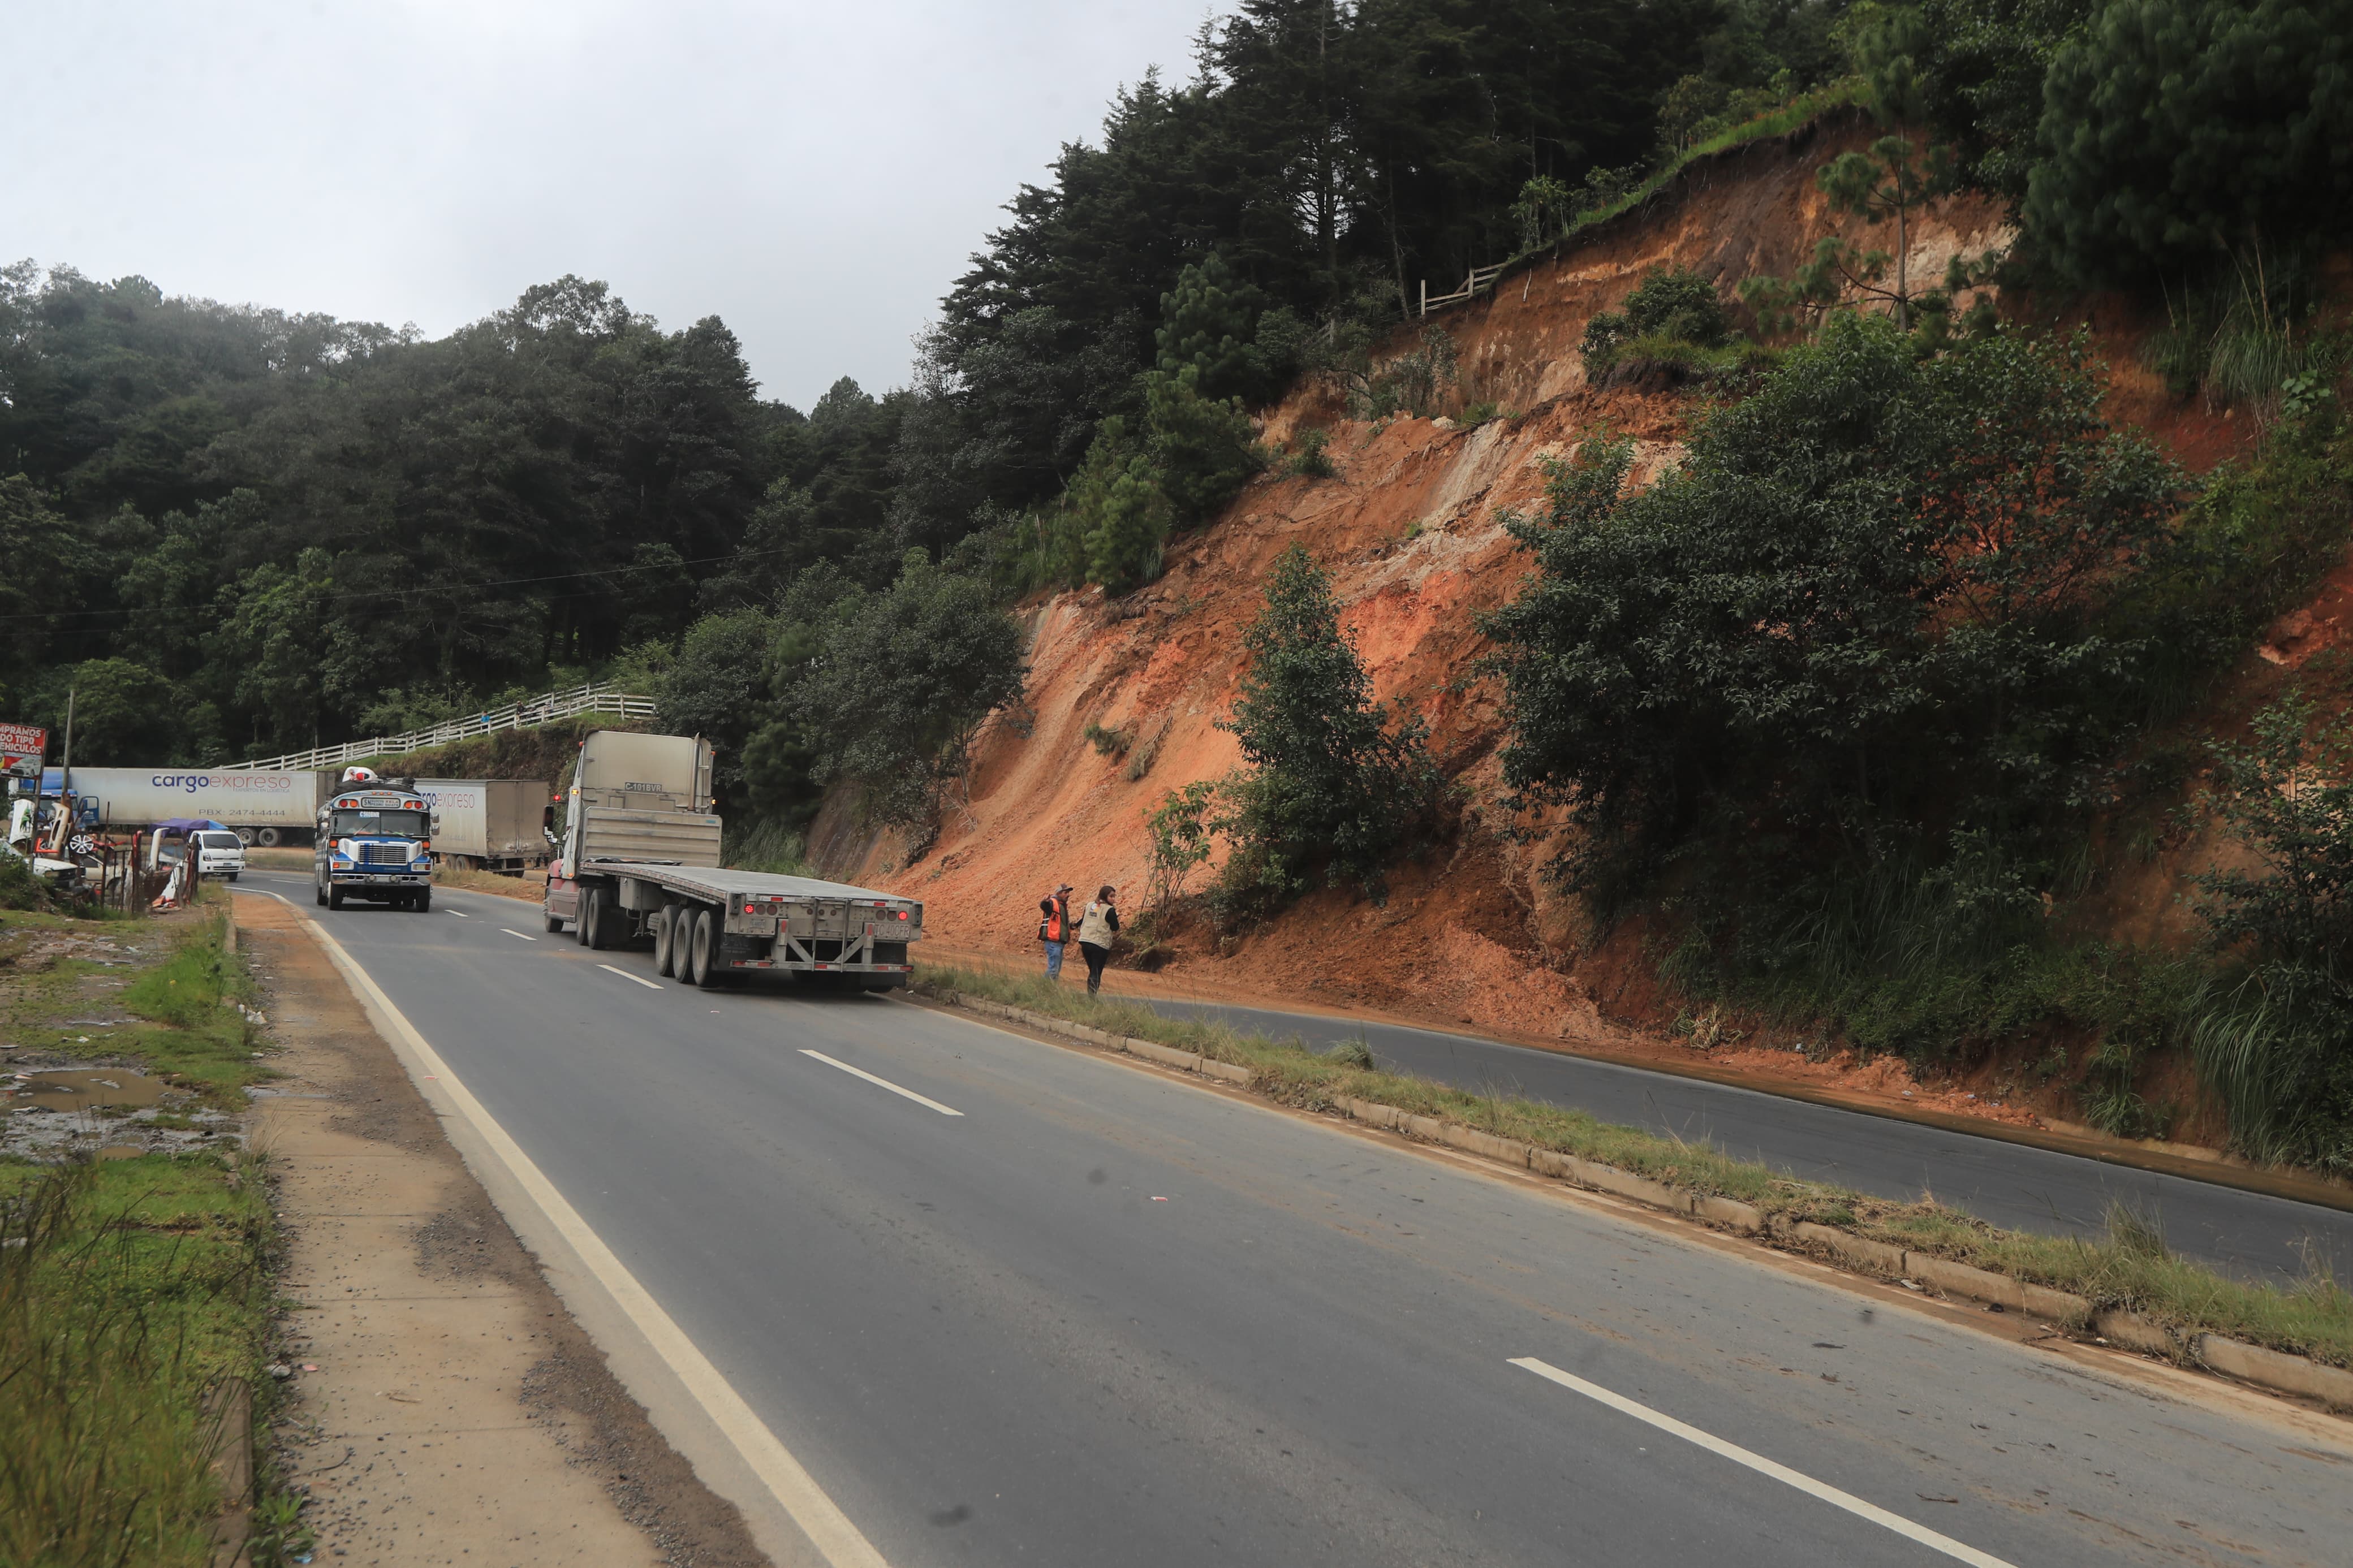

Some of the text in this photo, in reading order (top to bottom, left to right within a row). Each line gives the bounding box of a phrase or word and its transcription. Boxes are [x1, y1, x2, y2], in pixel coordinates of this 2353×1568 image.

[15, 735, 35, 745] TIPO
[152, 775, 291, 793] cargoexpreso
[626, 783, 661, 792] C-101BVR
